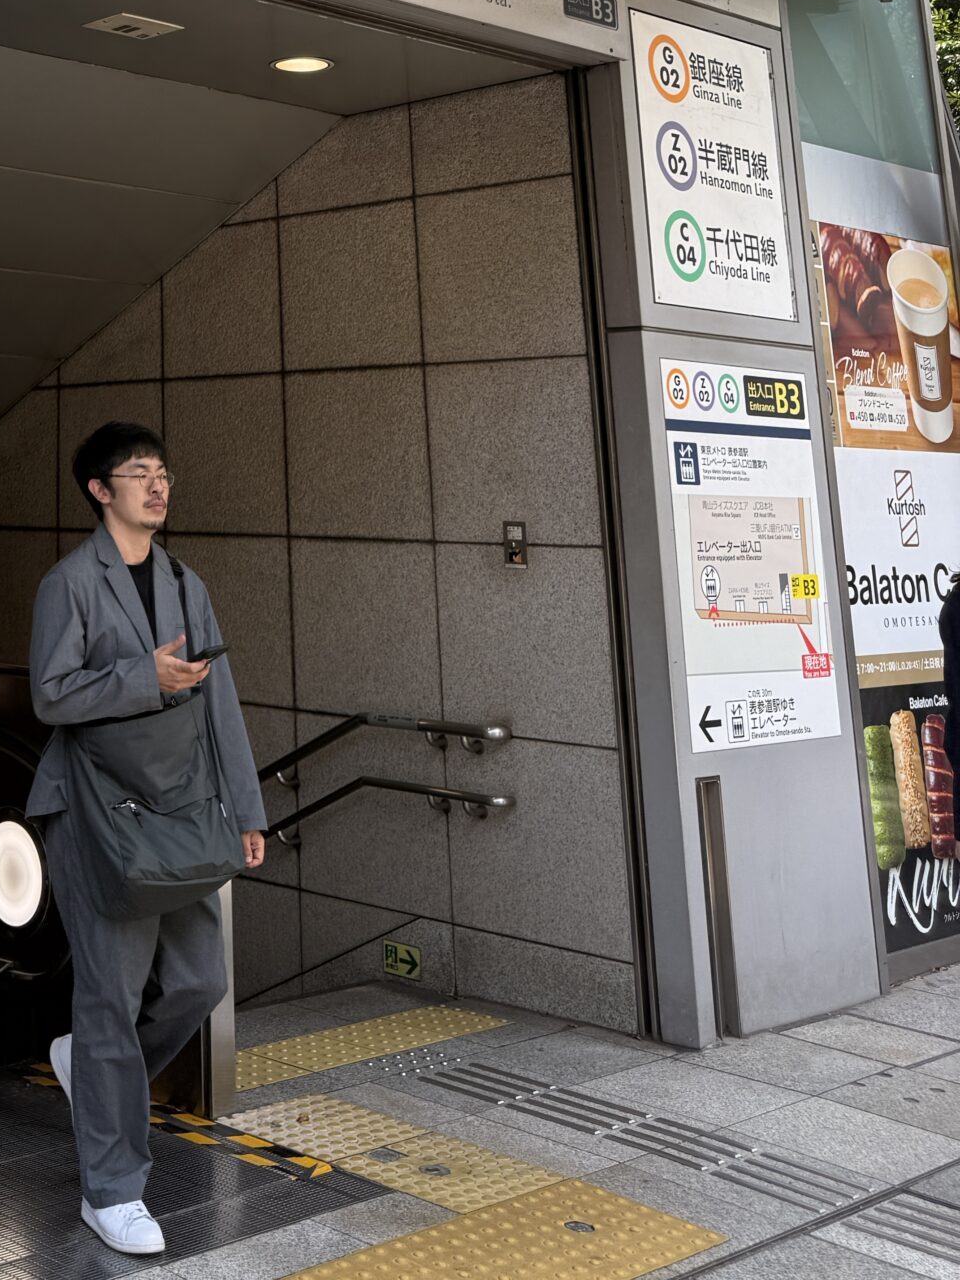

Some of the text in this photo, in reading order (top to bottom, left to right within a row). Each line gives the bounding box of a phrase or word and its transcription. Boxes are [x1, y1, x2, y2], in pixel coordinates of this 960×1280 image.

[663, 46, 674, 64] G
[660, 66, 680, 89] 02
[689, 52, 744, 93] 銀座線
[692, 85, 742, 109] Ginza Line
[671, 133, 680, 152] Z
[668, 154, 688, 177] 02
[698, 138, 770, 181] 半蔵門線
[700, 171, 773, 200] Hanzomon Line
[680, 223, 689, 242] C
[706, 226, 778, 267] 千代田線
[677, 244, 697, 266] 04
[709, 260, 771, 283] Chiyoda Line
[674, 376, 680, 387] G
[701, 378, 706, 389] Z
[726, 381, 731, 391] C
[672, 388, 685, 400] 02
[699, 390, 710, 402] 02
[724, 392, 734, 404] 04
[748, 382, 774, 399] 出入口
[750, 402, 775, 412] Entrance
[776, 383, 800, 415] B3
[701, 446, 726, 455] 東京メトロ
[697, 540, 761, 553] エレベーター出入口
[804, 580, 816, 595] B3
[846, 564, 930, 605] Balaton
[805, 656, 826, 669] 現在地
[749, 698, 795, 714] 表参道駅ゆき
[909, 697, 933, 709] Balaton
[751, 714, 796, 729] エレベーター
[752, 731, 769, 739] Elevator
